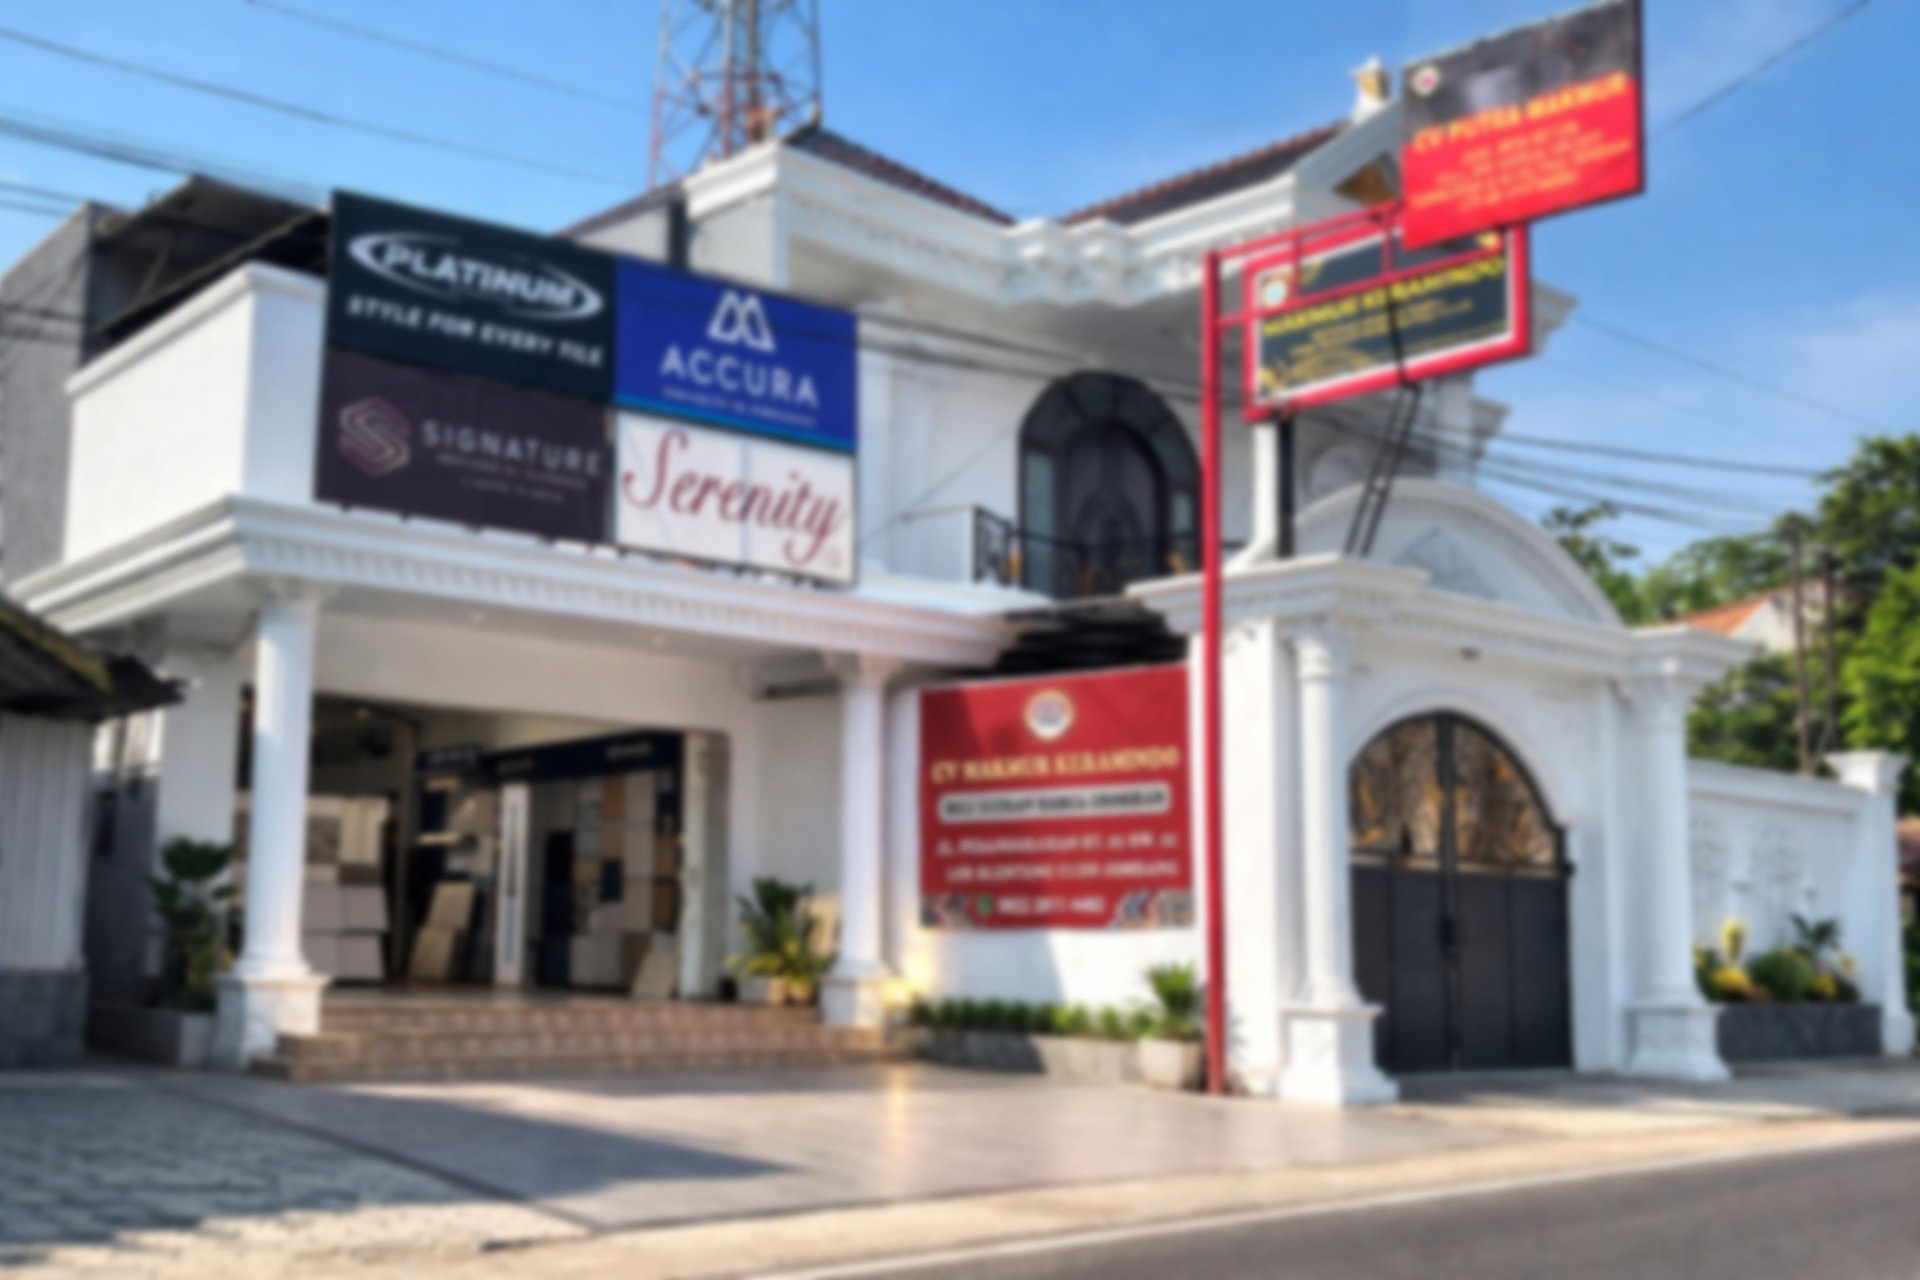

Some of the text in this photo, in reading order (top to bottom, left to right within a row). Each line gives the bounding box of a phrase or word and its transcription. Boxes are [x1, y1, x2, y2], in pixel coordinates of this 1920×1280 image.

[1412, 125, 1445, 154] CV
[1447, 103, 1521, 143] PUTRA
[1525, 69, 1628, 120] MAKMUR
[383, 242, 575, 309] PLATINUM
[348, 296, 603, 367] STYLE FOR EVERY TILE
[659, 344, 820, 409] ACCURA
[422, 419, 602, 477] SIGNATURE
[622, 427, 847, 567] Serenity
